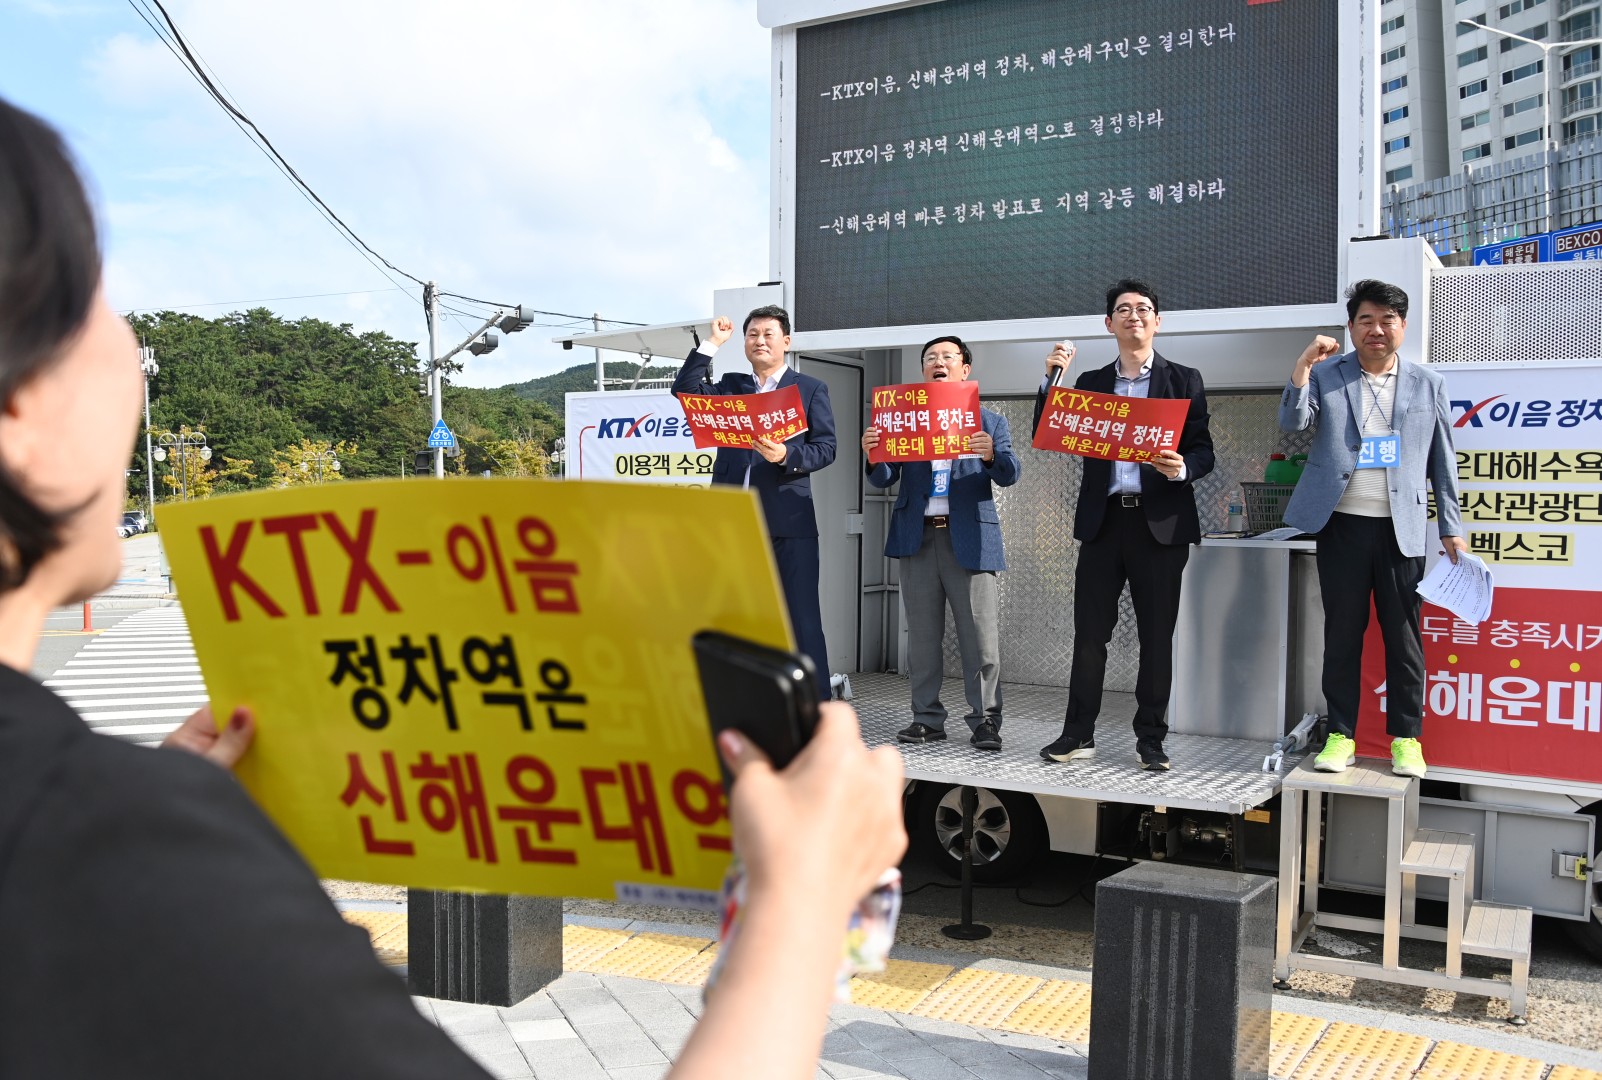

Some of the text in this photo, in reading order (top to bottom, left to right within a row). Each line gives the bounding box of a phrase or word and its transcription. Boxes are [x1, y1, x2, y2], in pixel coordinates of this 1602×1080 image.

[907, 60, 987, 90] 신해운대역
[995, 54, 1035, 77] 정차,
[1041, 36, 1151, 69] 해운대구민은
[1159, 23, 1237, 52] 결의한다
[902, 135, 948, 160] 정차역
[955, 121, 1077, 152] 신해운대역으로
[1089, 109, 1165, 136] 결정하라
[915, 206, 947, 226] 빠른
[952, 202, 986, 223] 정차
[992, 198, 1044, 219] 발표로
[1056, 191, 1089, 213] 지역
[1098, 187, 1136, 210] 갈등
[1149, 178, 1226, 205] 해결하라
[1505, 242, 1535, 258] 해운대
[1557, 231, 1600, 251] BEXCO
[683, 396, 747, 412] KTX-이음
[874, 389, 929, 409] KTX-이음
[1051, 390, 1131, 418] KTX-이음
[691, 407, 799, 431] 신해운대역 정차로
[874, 408, 976, 433] 신해운대역 정차로
[1049, 410, 1175, 448] 신해운대역 정차로
[712, 431, 754, 446] 해운대
[886, 436, 925, 456] 해운대
[1061, 434, 1112, 457] 해운대
[616, 454, 670, 476] 이용객
[1471, 533, 1568, 561] 벡스코
[199, 507, 582, 623] KTX-이음
[324, 634, 588, 732] 정차역은
